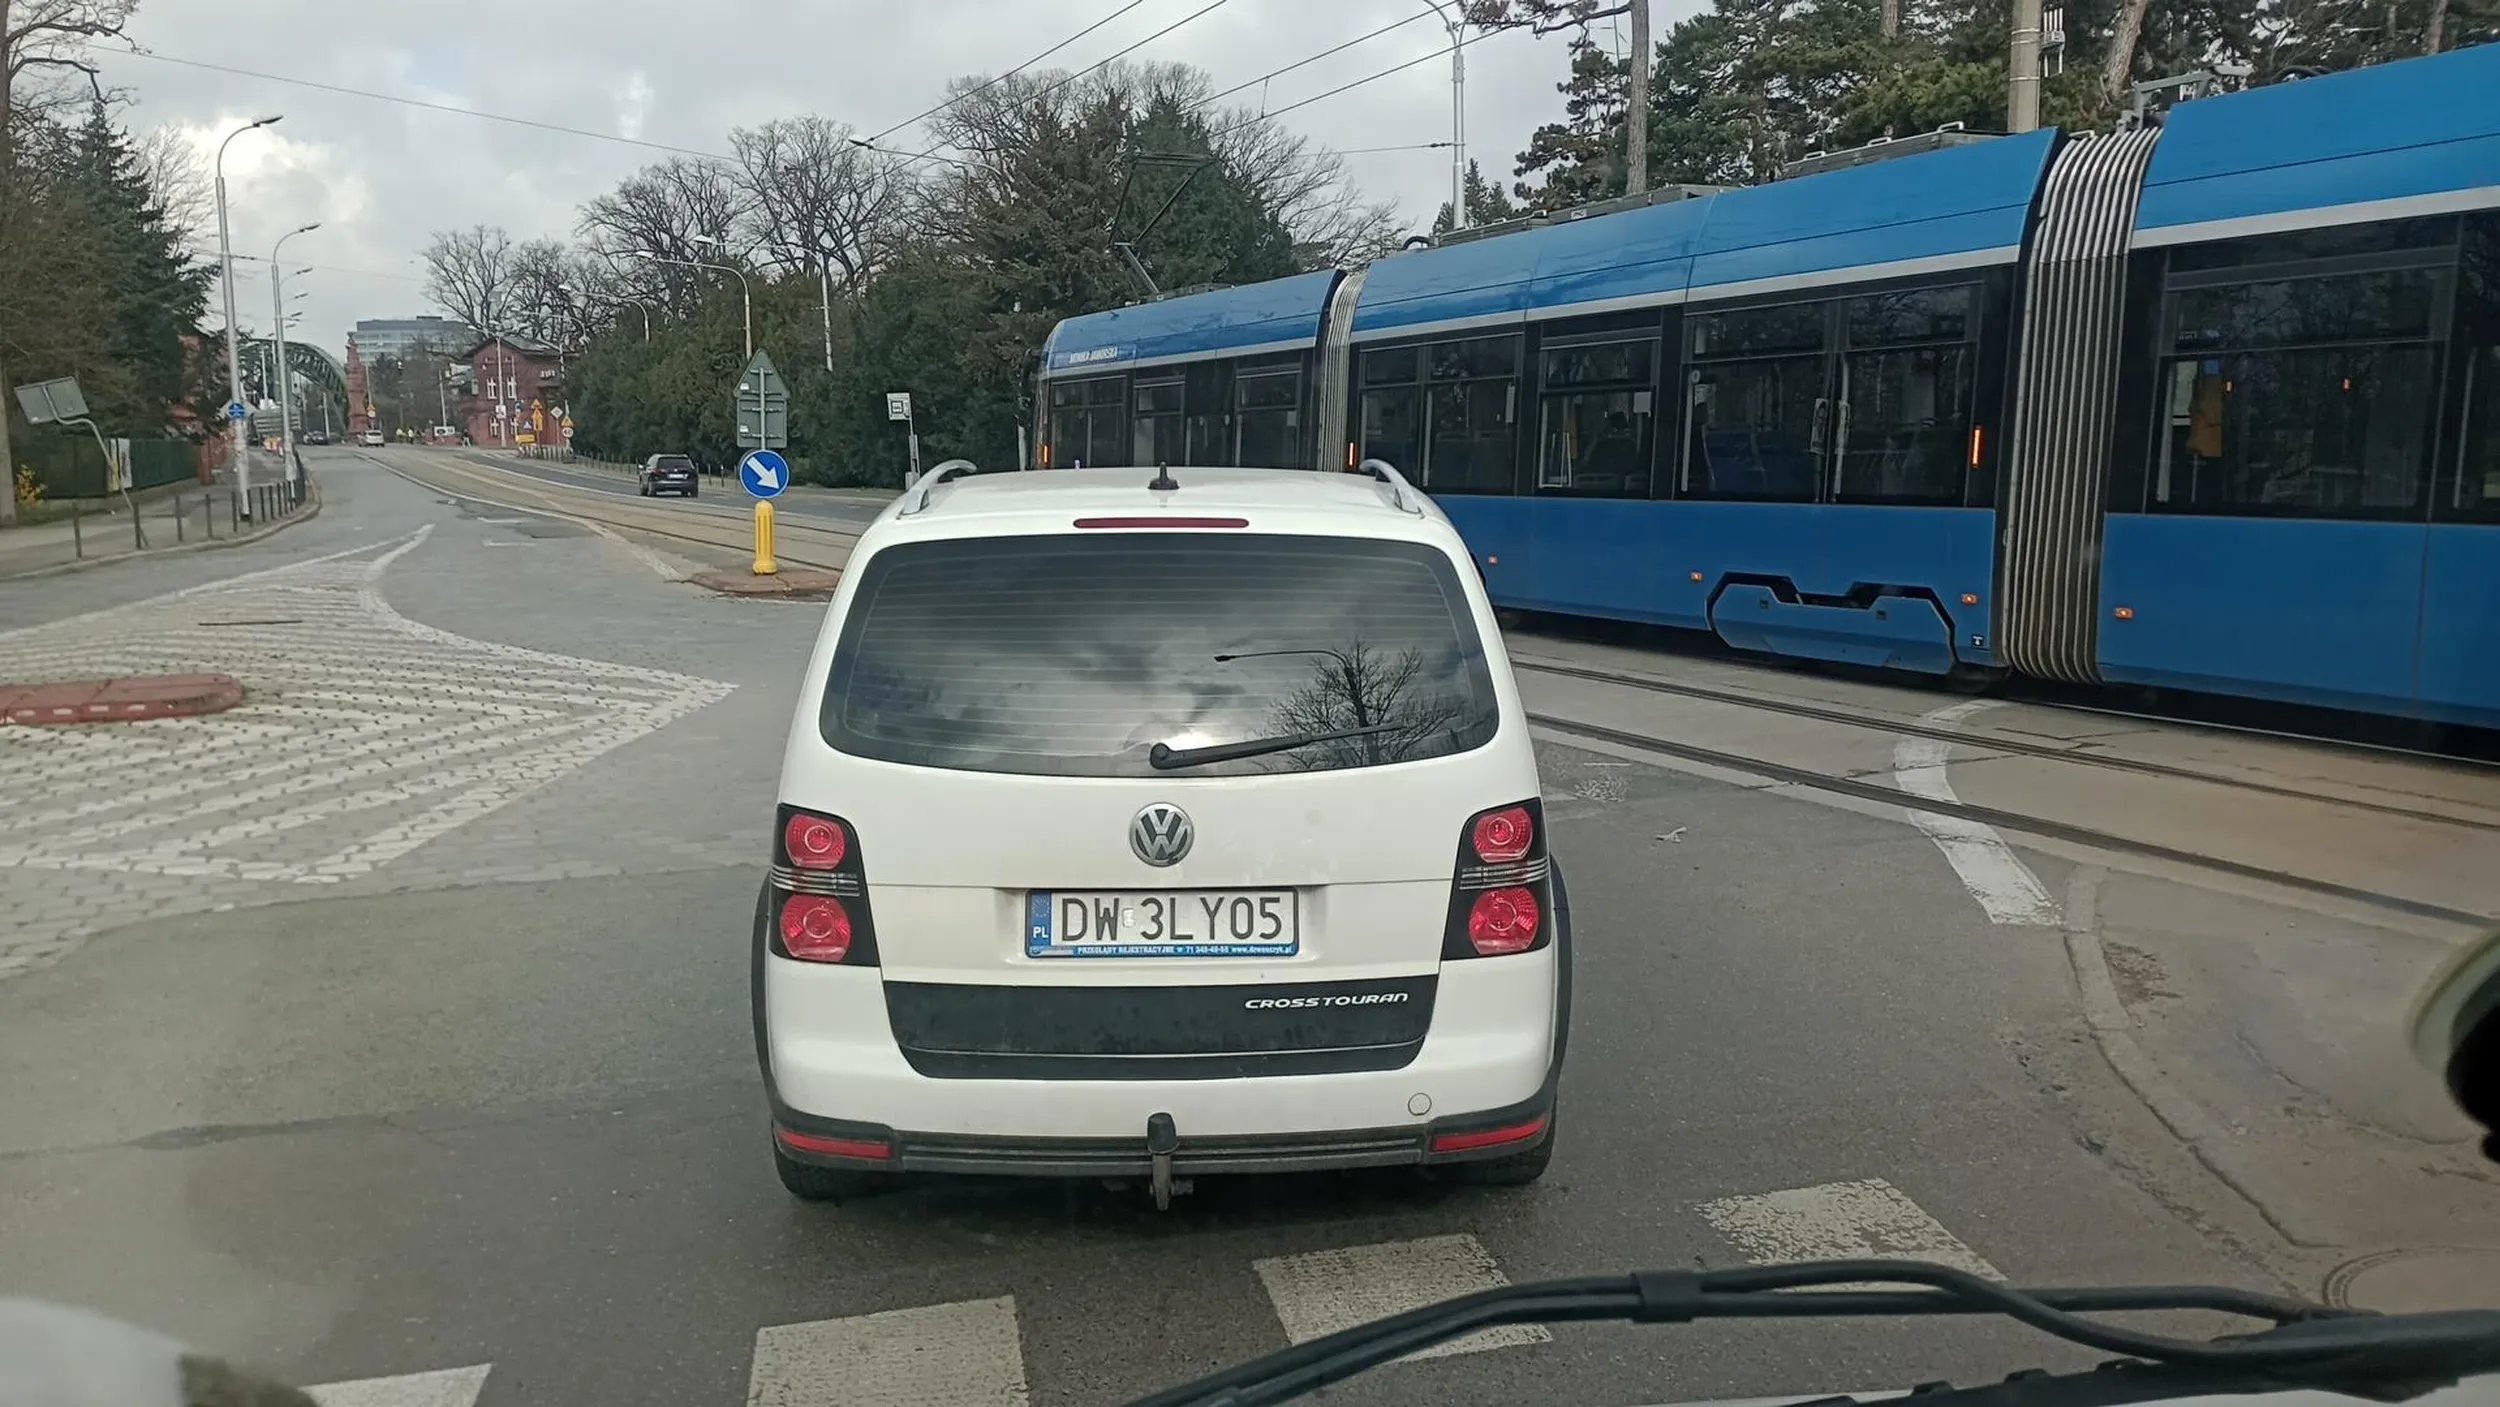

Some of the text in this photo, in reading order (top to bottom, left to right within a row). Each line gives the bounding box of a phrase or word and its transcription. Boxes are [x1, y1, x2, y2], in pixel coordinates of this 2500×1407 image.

[1033, 926, 1049, 938] PL
[1062, 897, 1282, 941] DW 3LY05
